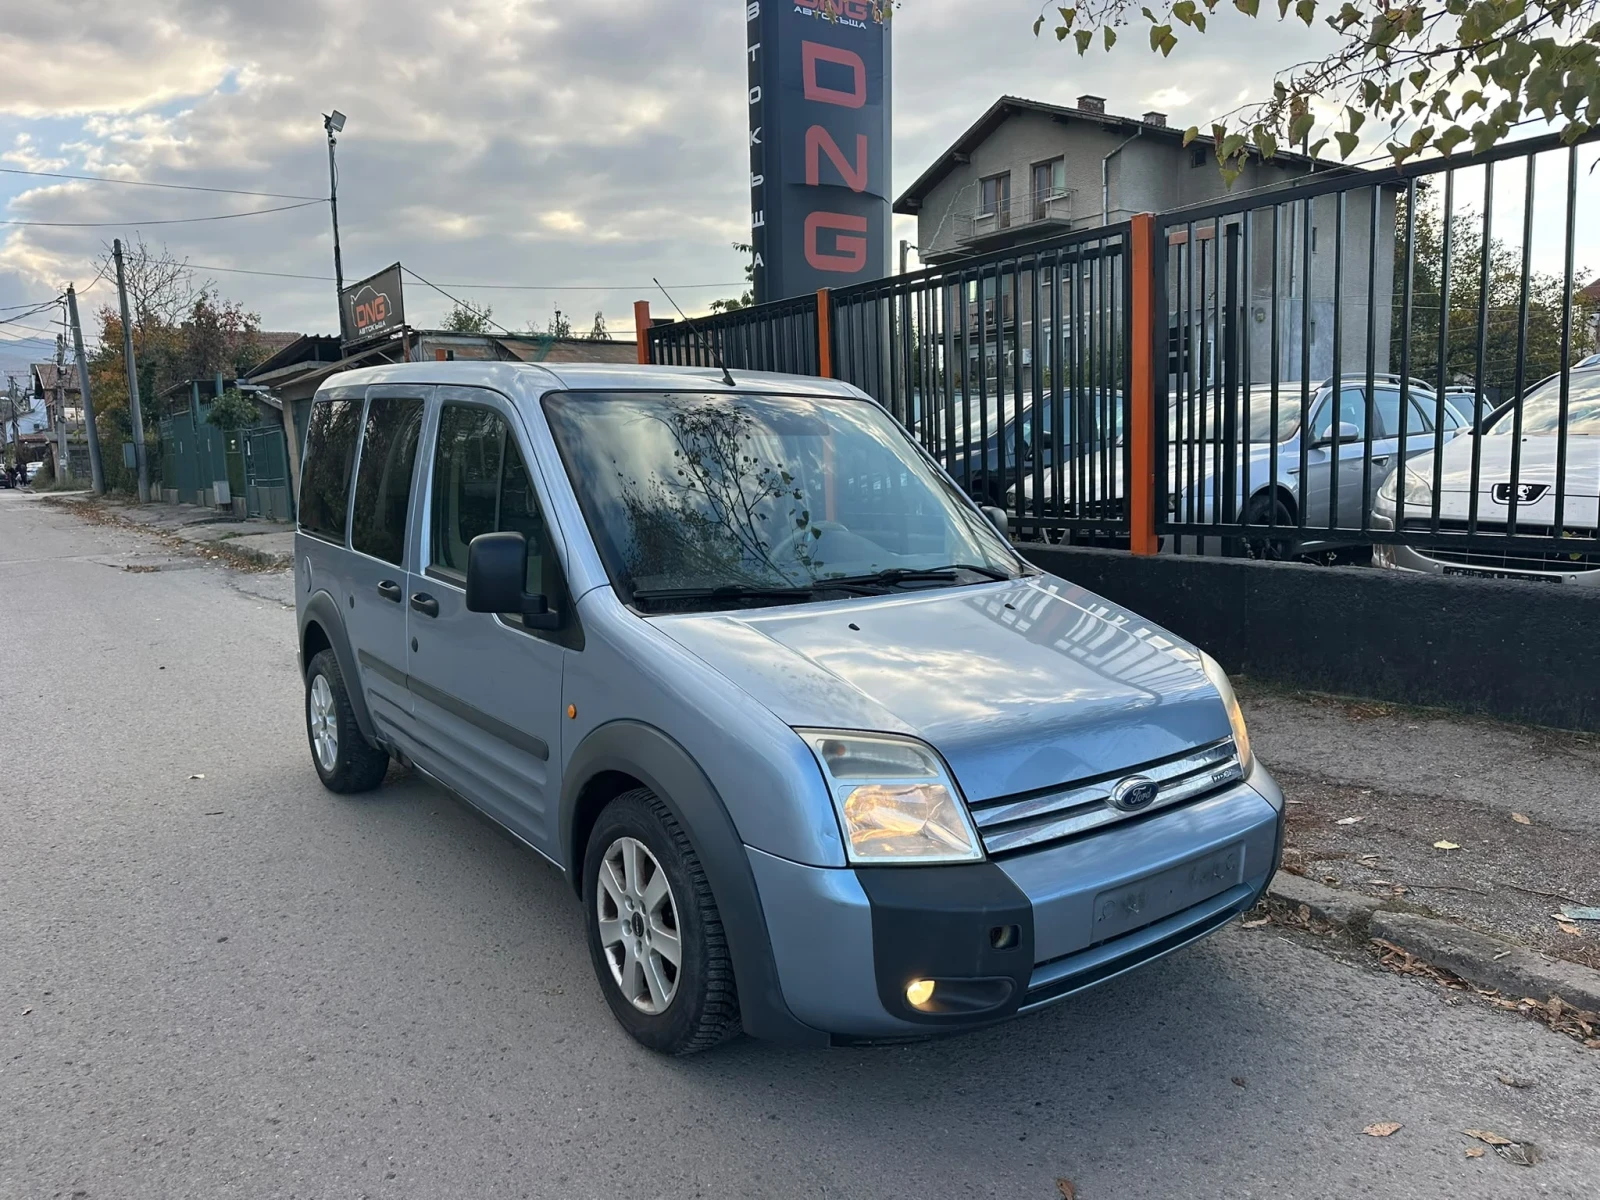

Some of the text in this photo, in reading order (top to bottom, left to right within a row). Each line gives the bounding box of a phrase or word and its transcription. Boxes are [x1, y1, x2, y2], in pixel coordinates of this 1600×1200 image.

[802, 40, 868, 273] DNG
[355, 296, 385, 328] DNG
[1130, 785, 1152, 804] Ford
